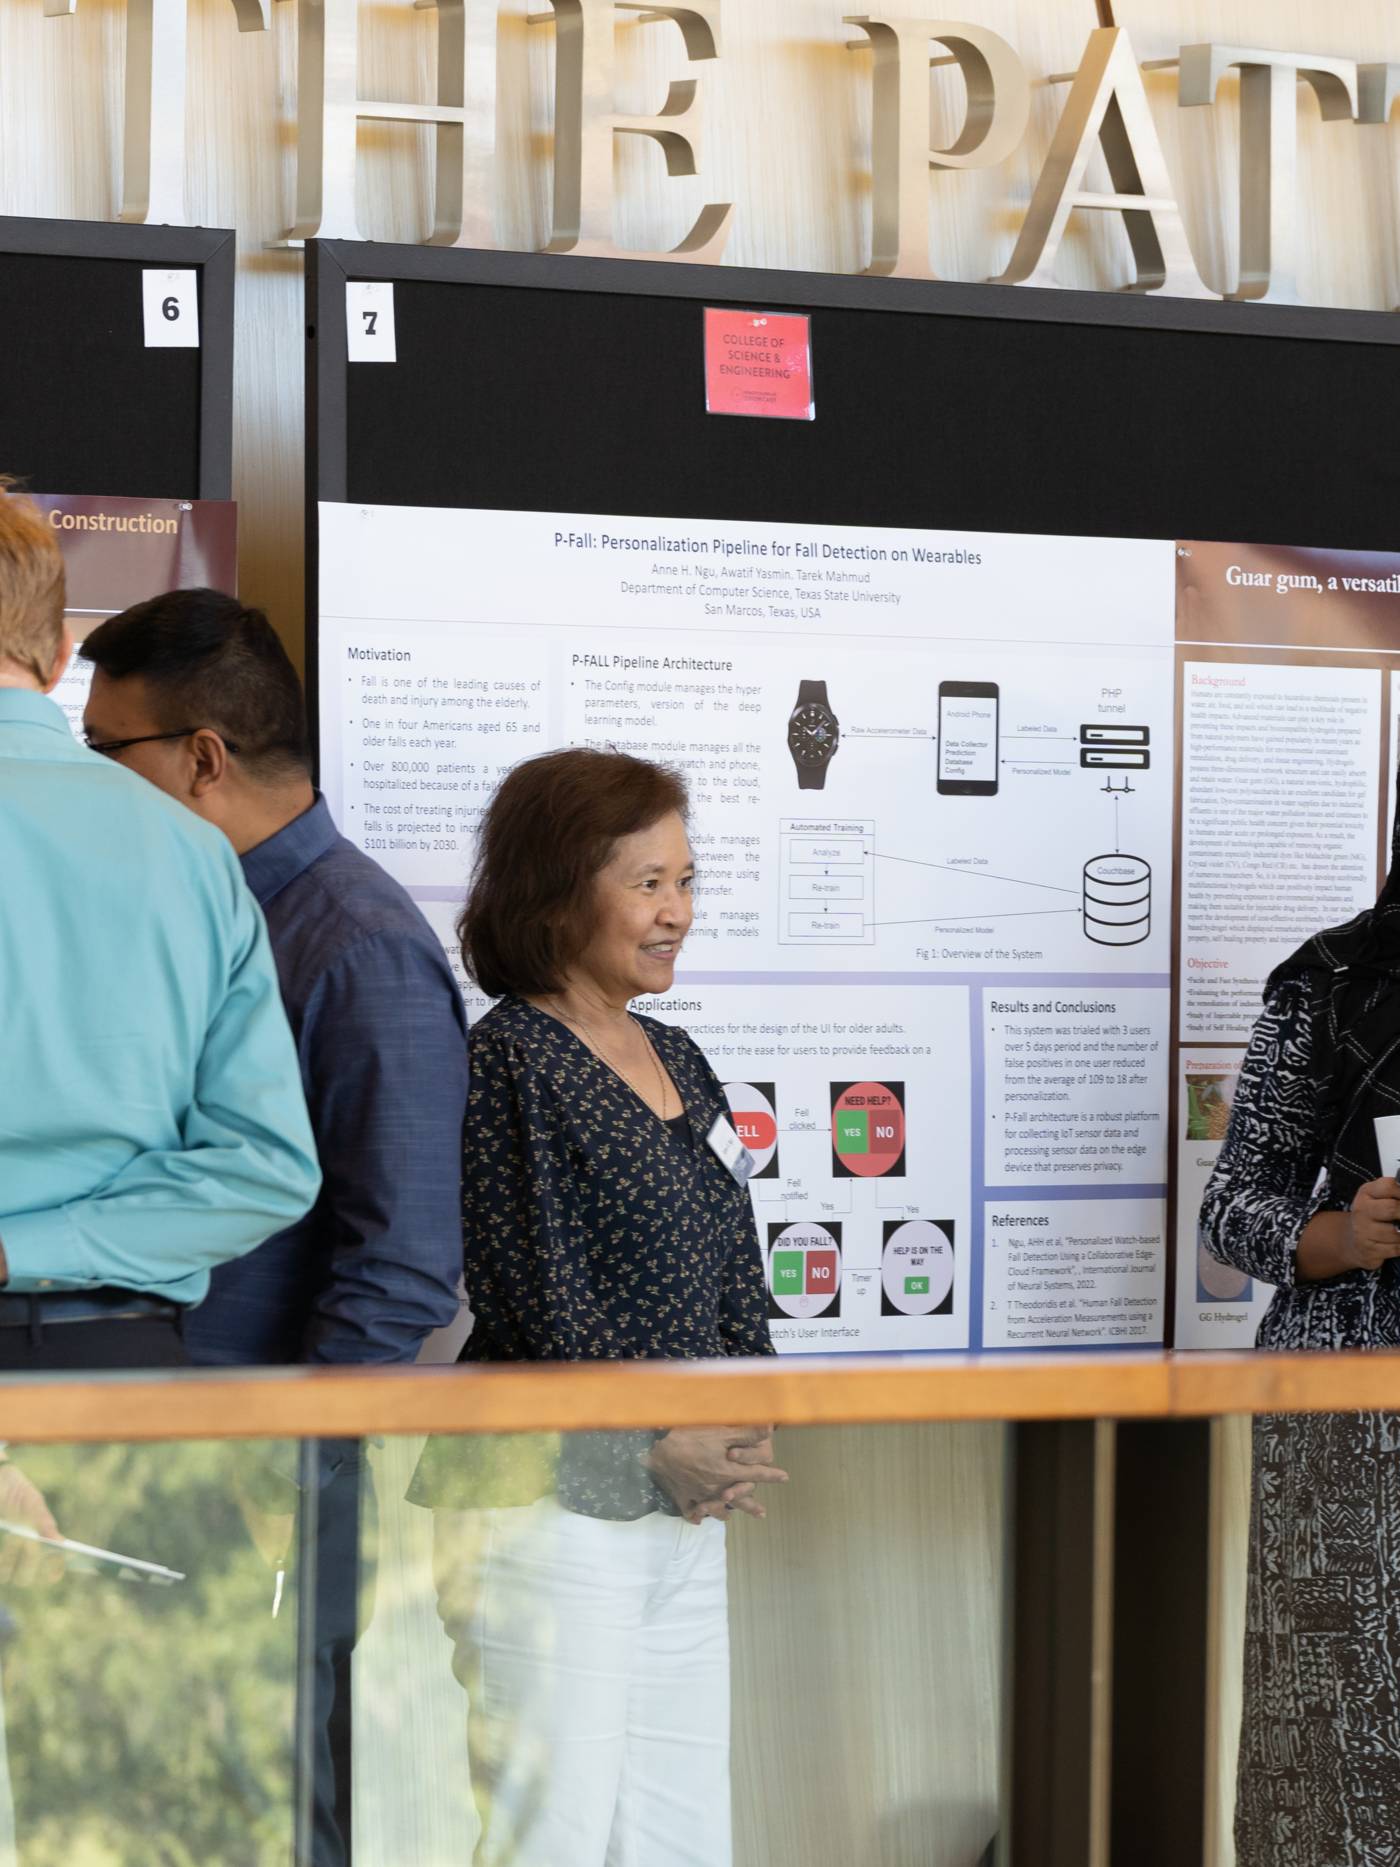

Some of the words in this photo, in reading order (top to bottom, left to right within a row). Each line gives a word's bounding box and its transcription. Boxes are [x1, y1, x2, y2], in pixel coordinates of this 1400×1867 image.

[44, 0, 733, 267] THE
[163, 297, 179, 321] 6
[363, 312, 377, 334] 7
[723, 334, 768, 347] COLLEGE
[770, 338, 784, 348] OF
[728, 350, 771, 362] SCIENCE
[775, 353, 781, 363] &
[720, 364, 790, 379] ENGINEERING
[48, 508, 176, 535] Construction
[554, 532, 596, 547] P-Fall:
[601, 534, 708, 552] Personalization
[713, 539, 767, 557] Pipeline
[771, 540, 790, 556] for
[795, 542, 817, 557] Fall
[822, 544, 886, 560] Detection
[891, 550, 907, 560] on
[912, 548, 981, 564] Wearables
[651, 563, 678, 575] Anne
[681, 565, 691, 575] H.
[695, 565, 717, 579] Ngu,
[720, 566, 753, 578] Awatif
[795, 569, 823, 581] Tarek
[826, 570, 870, 583] Mahmud
[1226, 566, 1271, 585] Guar
[1277, 574, 1322, 593] gum,
[1328, 577, 1337, 589] a
[620, 581, 683, 595] Department
[685, 583, 696, 595] of
[698, 584, 749, 598] Computer
[751, 586, 792, 600] Science,
[794, 587, 821, 599] Texas
[824, 589, 849, 600] State
[852, 591, 900, 605] University
[704, 603, 722, 614] San
[726, 604, 765, 617] Marcos,
[801, 607, 821, 618] USA
[348, 647, 410, 661] Motivation
[572, 654, 609, 667] P-FALL
[613, 655, 658, 670] Pipeline
[662, 657, 732, 670] Architecture
[361, 675, 376, 686] Fall
[381, 676, 388, 687] is
[393, 679, 411, 687] one
[416, 676, 427, 687] of
[432, 677, 448, 688] the
[454, 678, 488, 692] leading
[493, 681, 526, 694] causes
[529, 680, 541, 692] of
[916, 948, 929, 960] Fig
[931, 948, 939, 958] 1:
[941, 948, 982, 958] Overview
[983, 948, 993, 958] of
[994, 948, 1010, 959] the
[1011, 949, 1042, 960] System
[628, 997, 701, 1014] Applications
[991, 1000, 1029, 1012] Results
[1032, 1000, 1052, 1012] and
[1054, 1001, 1115, 1012] Conclusions
[844, 1096, 865, 1105] NEED
[867, 1096, 891, 1105] HELP?
[736, 1125, 760, 1137] ELL
[844, 1128, 861, 1137] YES
[876, 1127, 894, 1138] NO
[992, 1214, 1049, 1226] References
[776, 1237, 790, 1246] DID
[793, 1237, 808, 1246] YOU
[810, 1236, 833, 1246] FALL?
[893, 1246, 909, 1254] HELP
[911, 1246, 917, 1254] IS
[919, 1246, 928, 1254] ON
[781, 1270, 797, 1279] YES
[812, 1268, 830, 1279] NO
[911, 1281, 923, 1290] OK
[769, 1326, 795, 1341] atch's
[797, 1328, 818, 1338] User
[821, 1326, 859, 1337] Interface
